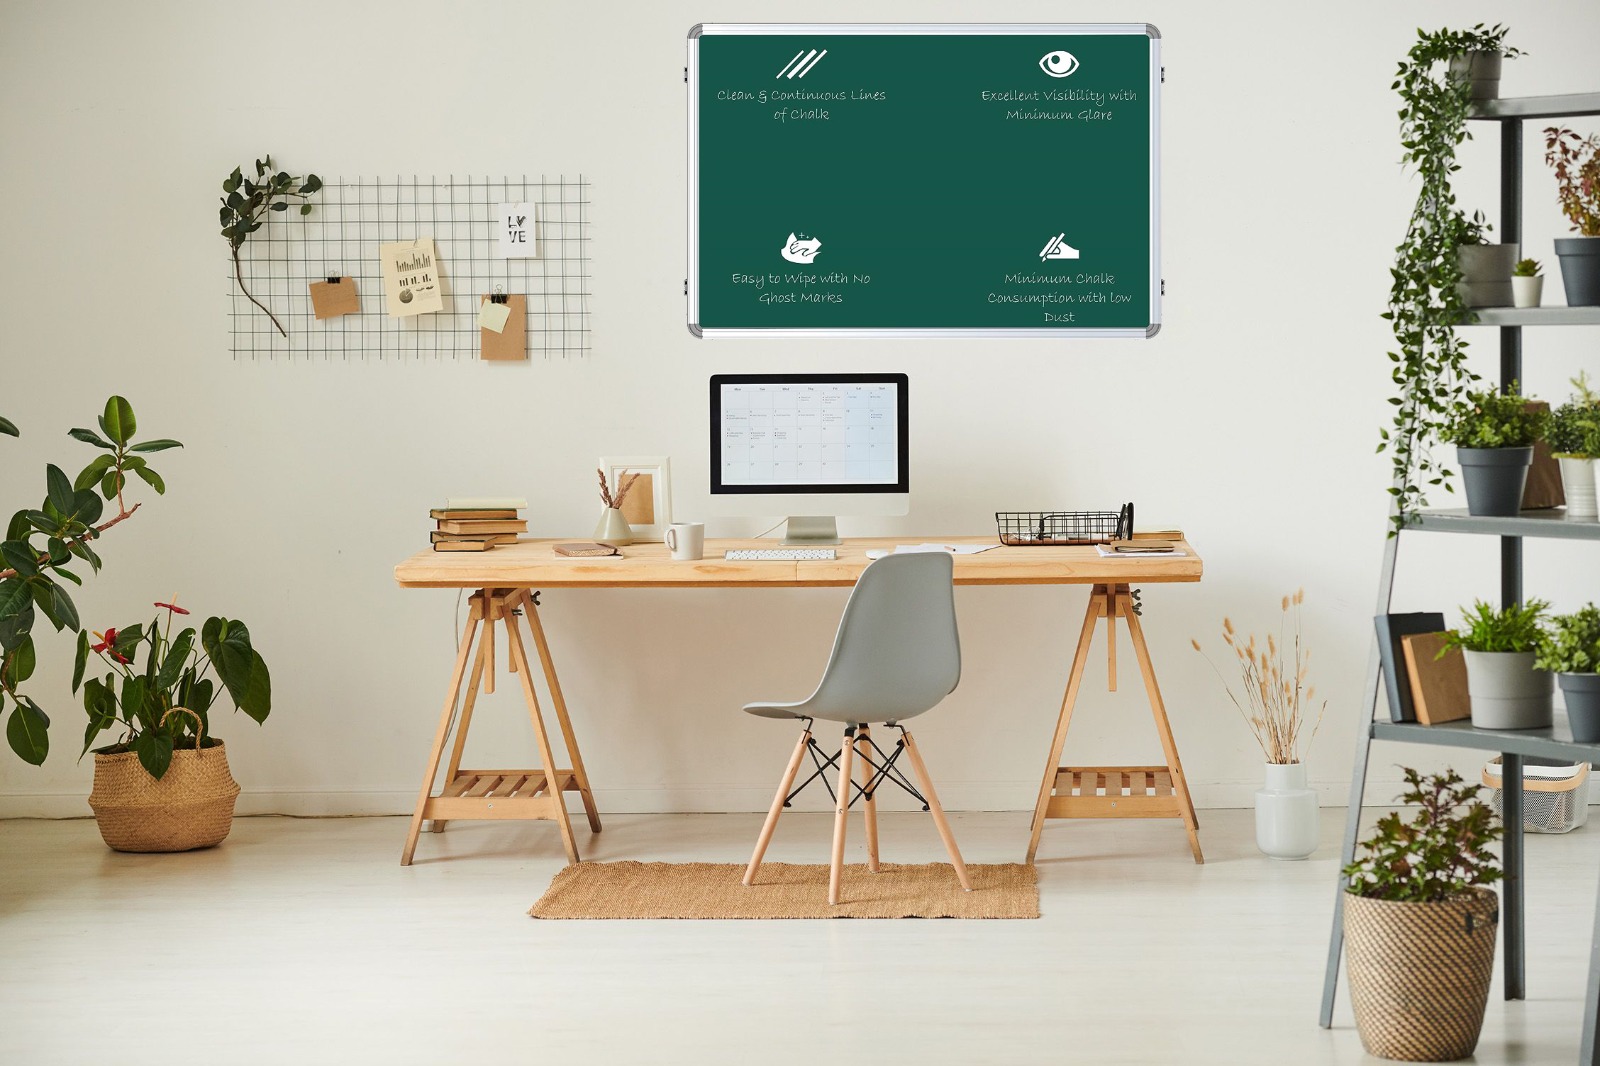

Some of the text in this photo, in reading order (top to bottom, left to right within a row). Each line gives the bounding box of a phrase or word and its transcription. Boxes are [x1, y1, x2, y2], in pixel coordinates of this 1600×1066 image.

[717, 89, 886, 103] Clean & Continuous Lines
[981, 89, 1137, 106] Excellent Visibility with
[773, 107, 830, 123] of Chalk
[1005, 108, 1113, 122] Minimum Glare
[732, 272, 871, 289] Easy to Wipe with No
[1004, 272, 1116, 284] Minimum Chalk
[758, 292, 843, 305] Ghost Marks
[987, 292, 1132, 307] Consumption with low
[1043, 311, 1076, 322] Dust
